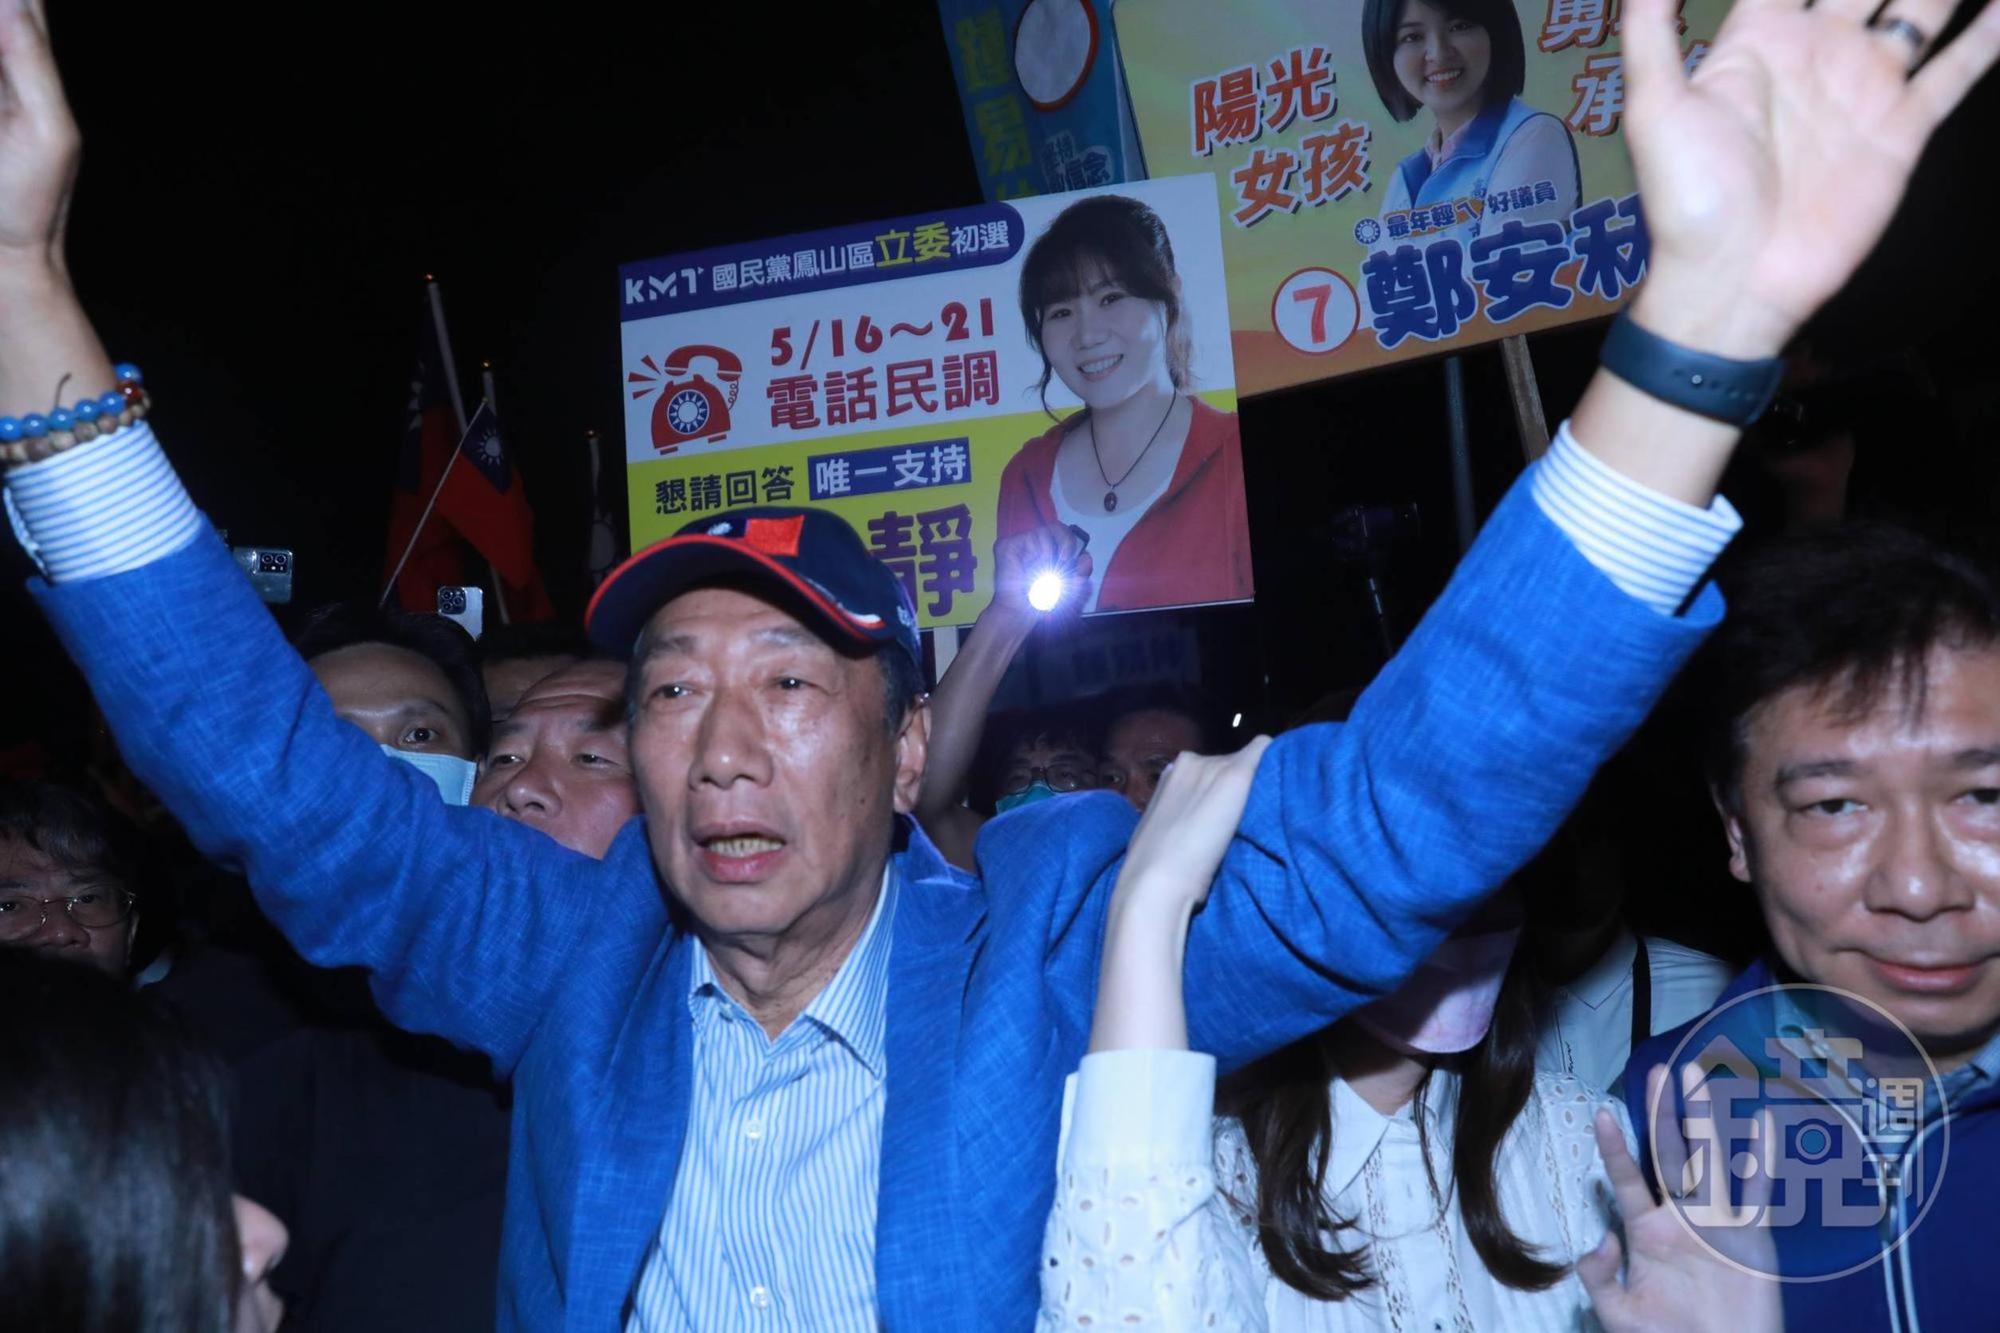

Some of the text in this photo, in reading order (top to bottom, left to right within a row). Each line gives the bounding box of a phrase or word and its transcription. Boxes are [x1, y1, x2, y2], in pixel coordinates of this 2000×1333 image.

[1193, 47, 1332, 152] 陽光
[1234, 123, 1368, 223] 女孩
[626, 220, 1010, 304] KMT 國民黨鳳山區立委初選
[1293, 285, 1332, 344] 7
[767, 350, 1000, 430] 電話民調
[655, 465, 795, 515] 懇請回答
[815, 445, 968, 496] 唯一支持
